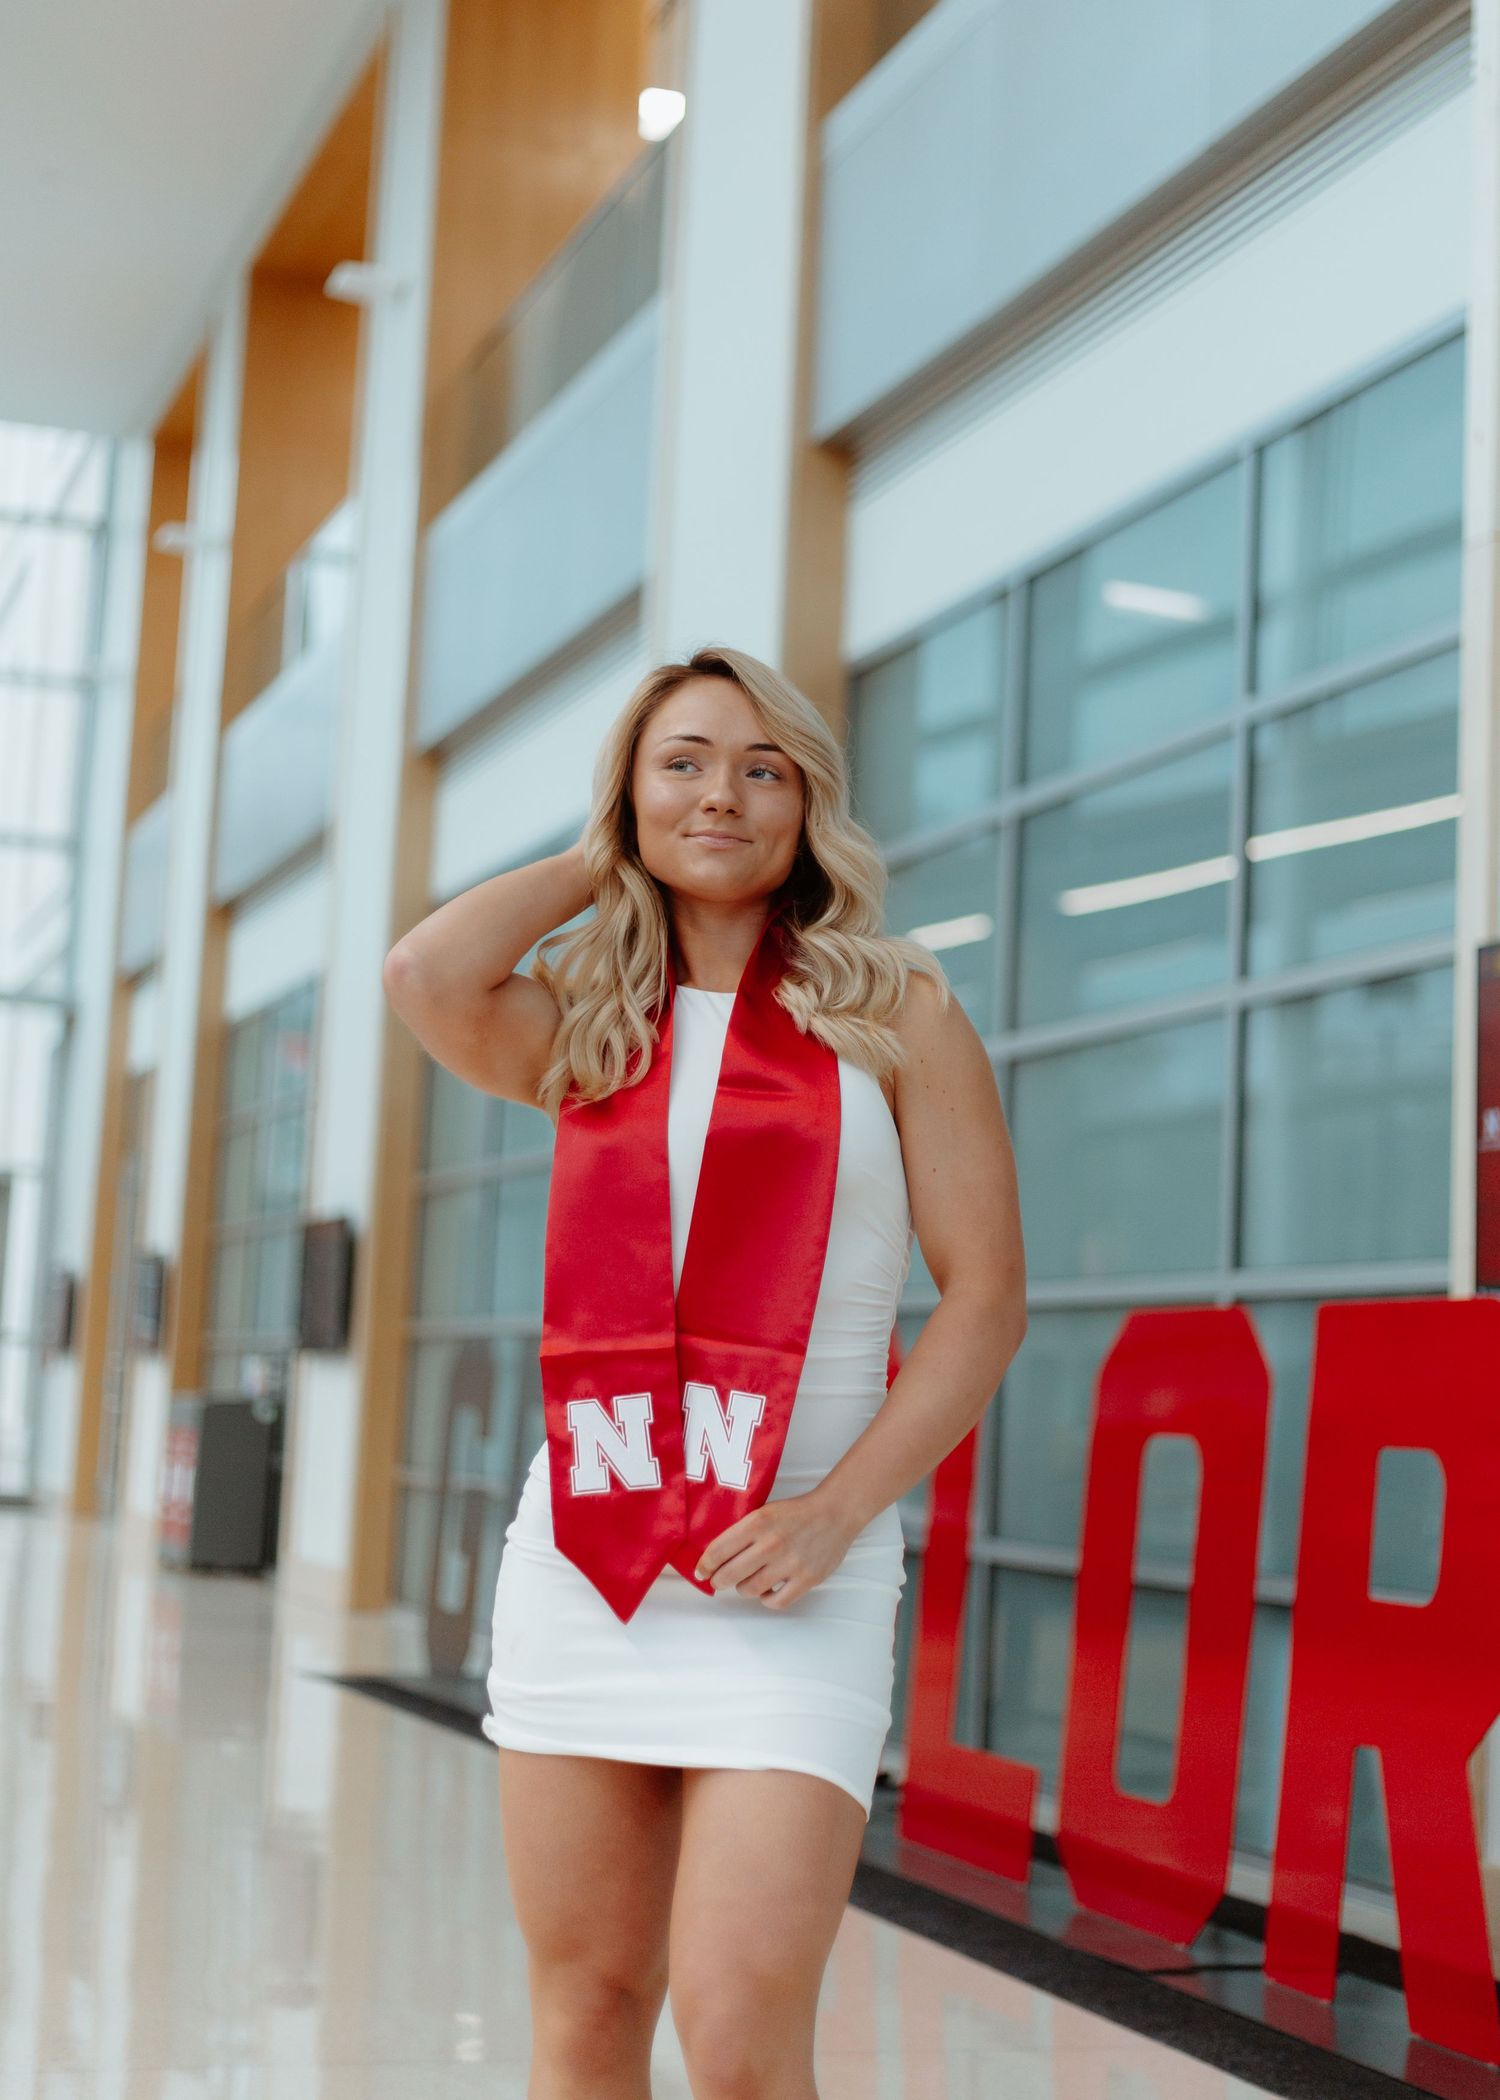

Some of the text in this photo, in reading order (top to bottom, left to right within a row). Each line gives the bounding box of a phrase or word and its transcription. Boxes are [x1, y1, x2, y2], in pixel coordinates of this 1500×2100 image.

[567, 1392, 662, 1496] N
[682, 1380, 767, 1491] N
[886, 1297, 1500, 2068] LOR
